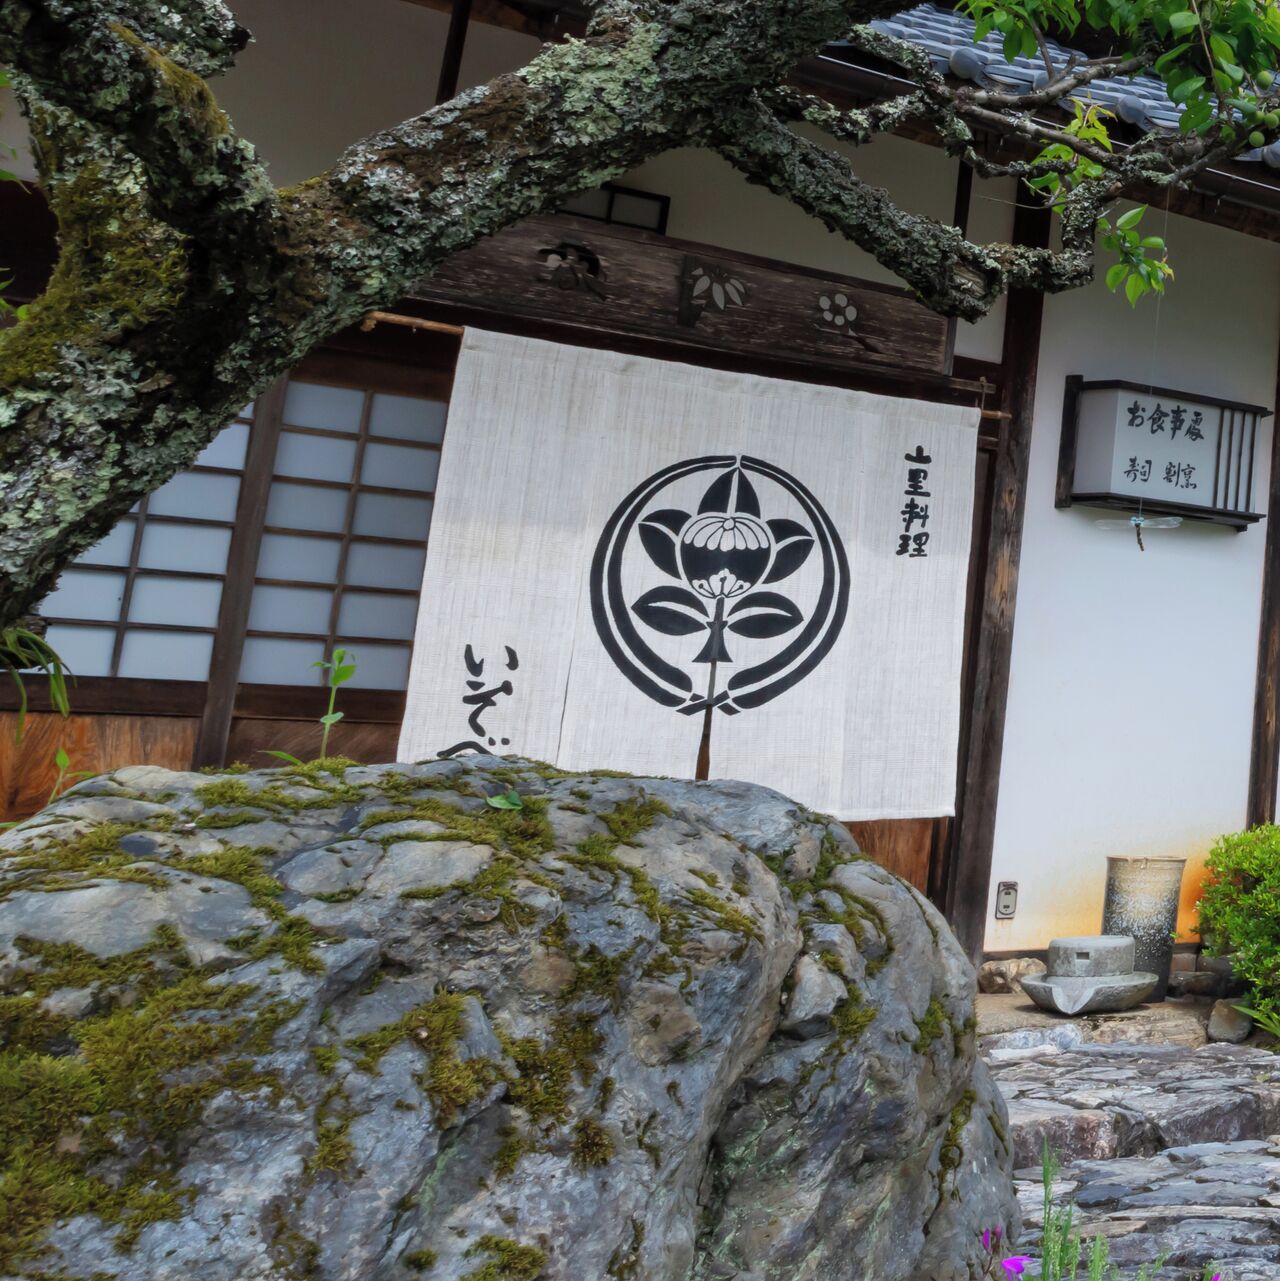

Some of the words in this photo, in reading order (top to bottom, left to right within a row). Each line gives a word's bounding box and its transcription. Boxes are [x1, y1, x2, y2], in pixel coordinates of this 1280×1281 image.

[895, 445, 932, 557] 山里料理
[1123, 456, 1152, 482] 寿司
[1163, 461, 1197, 489] 割烹
